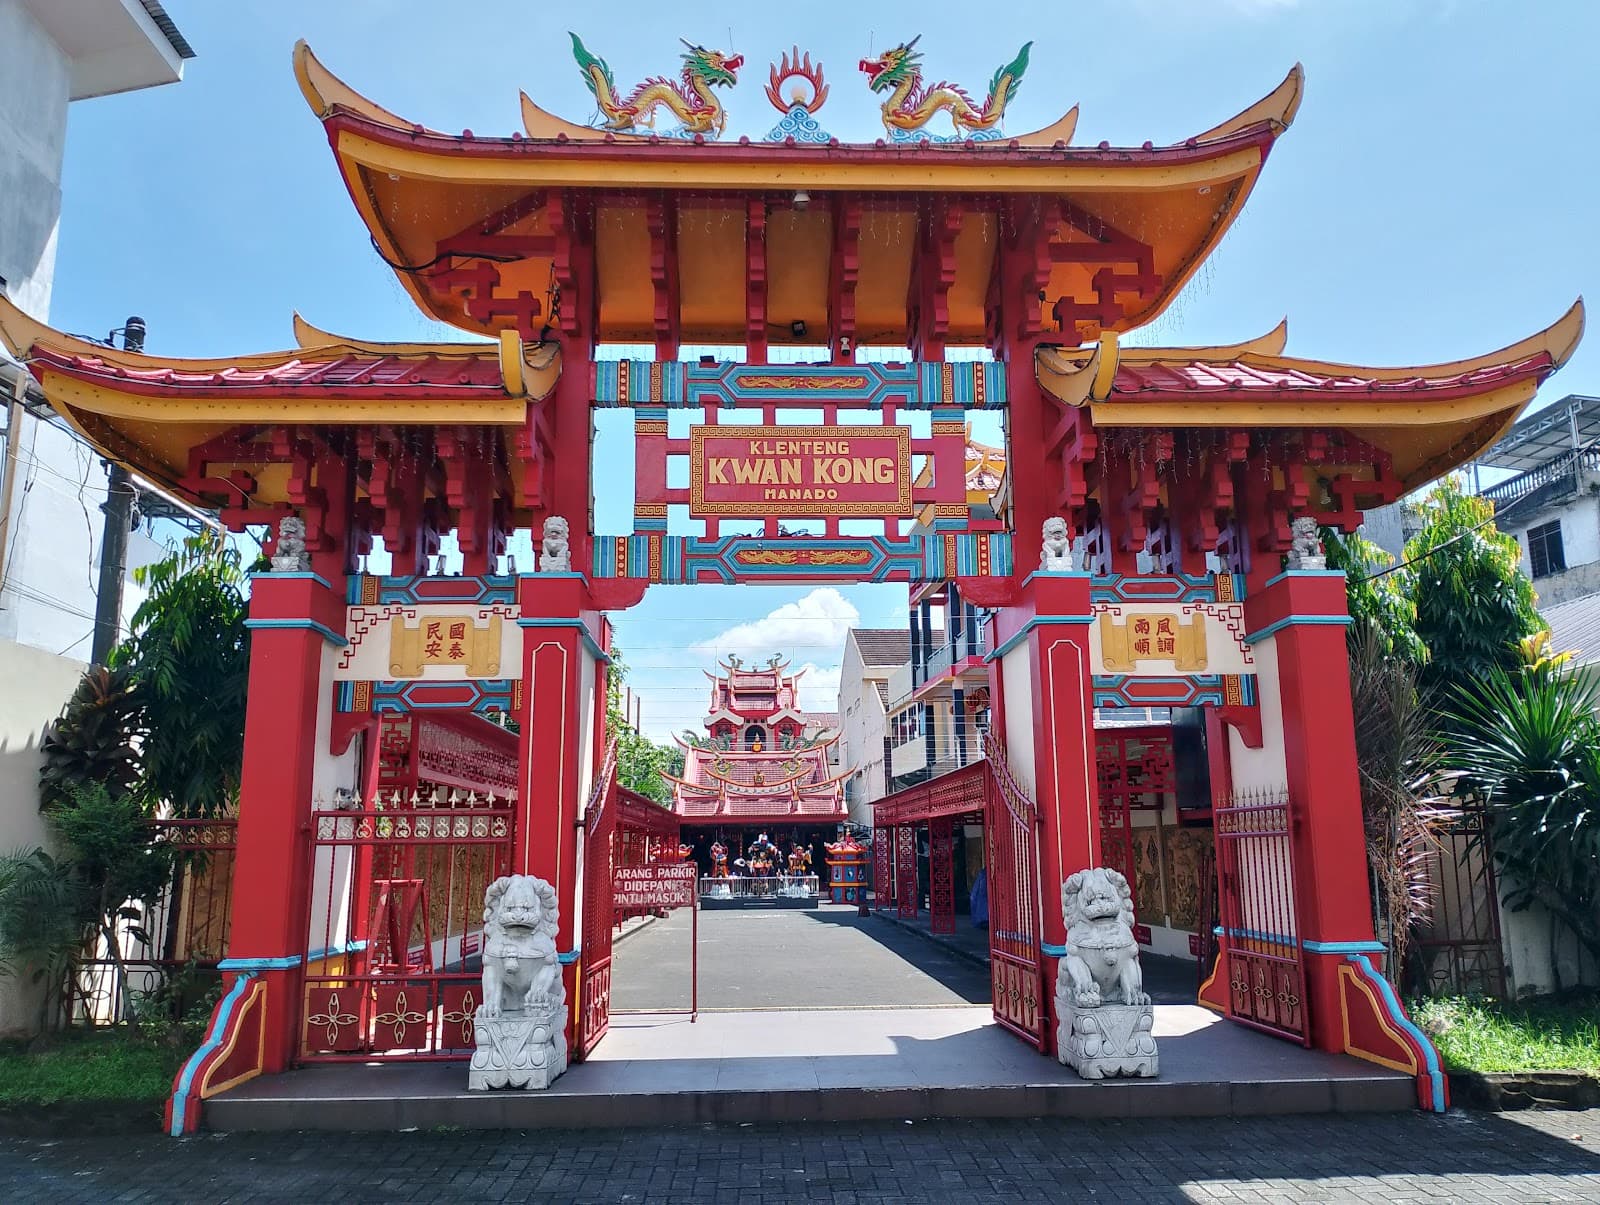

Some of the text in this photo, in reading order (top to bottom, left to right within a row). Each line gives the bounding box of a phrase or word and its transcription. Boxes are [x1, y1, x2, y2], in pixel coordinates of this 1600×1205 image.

[750, 441, 850, 455] KLENTENG
[708, 457, 895, 485] KWAN KONG
[764, 488, 838, 500] MANADO
[424, 622, 443, 659] 民安
[448, 622, 466, 660] 國泰
[1134, 618, 1151, 655] 雨順
[1156, 617, 1175, 655] 風調
[615, 867, 696, 880] ARANG PARKIR
[624, 880, 672, 892] DIDEPAN
